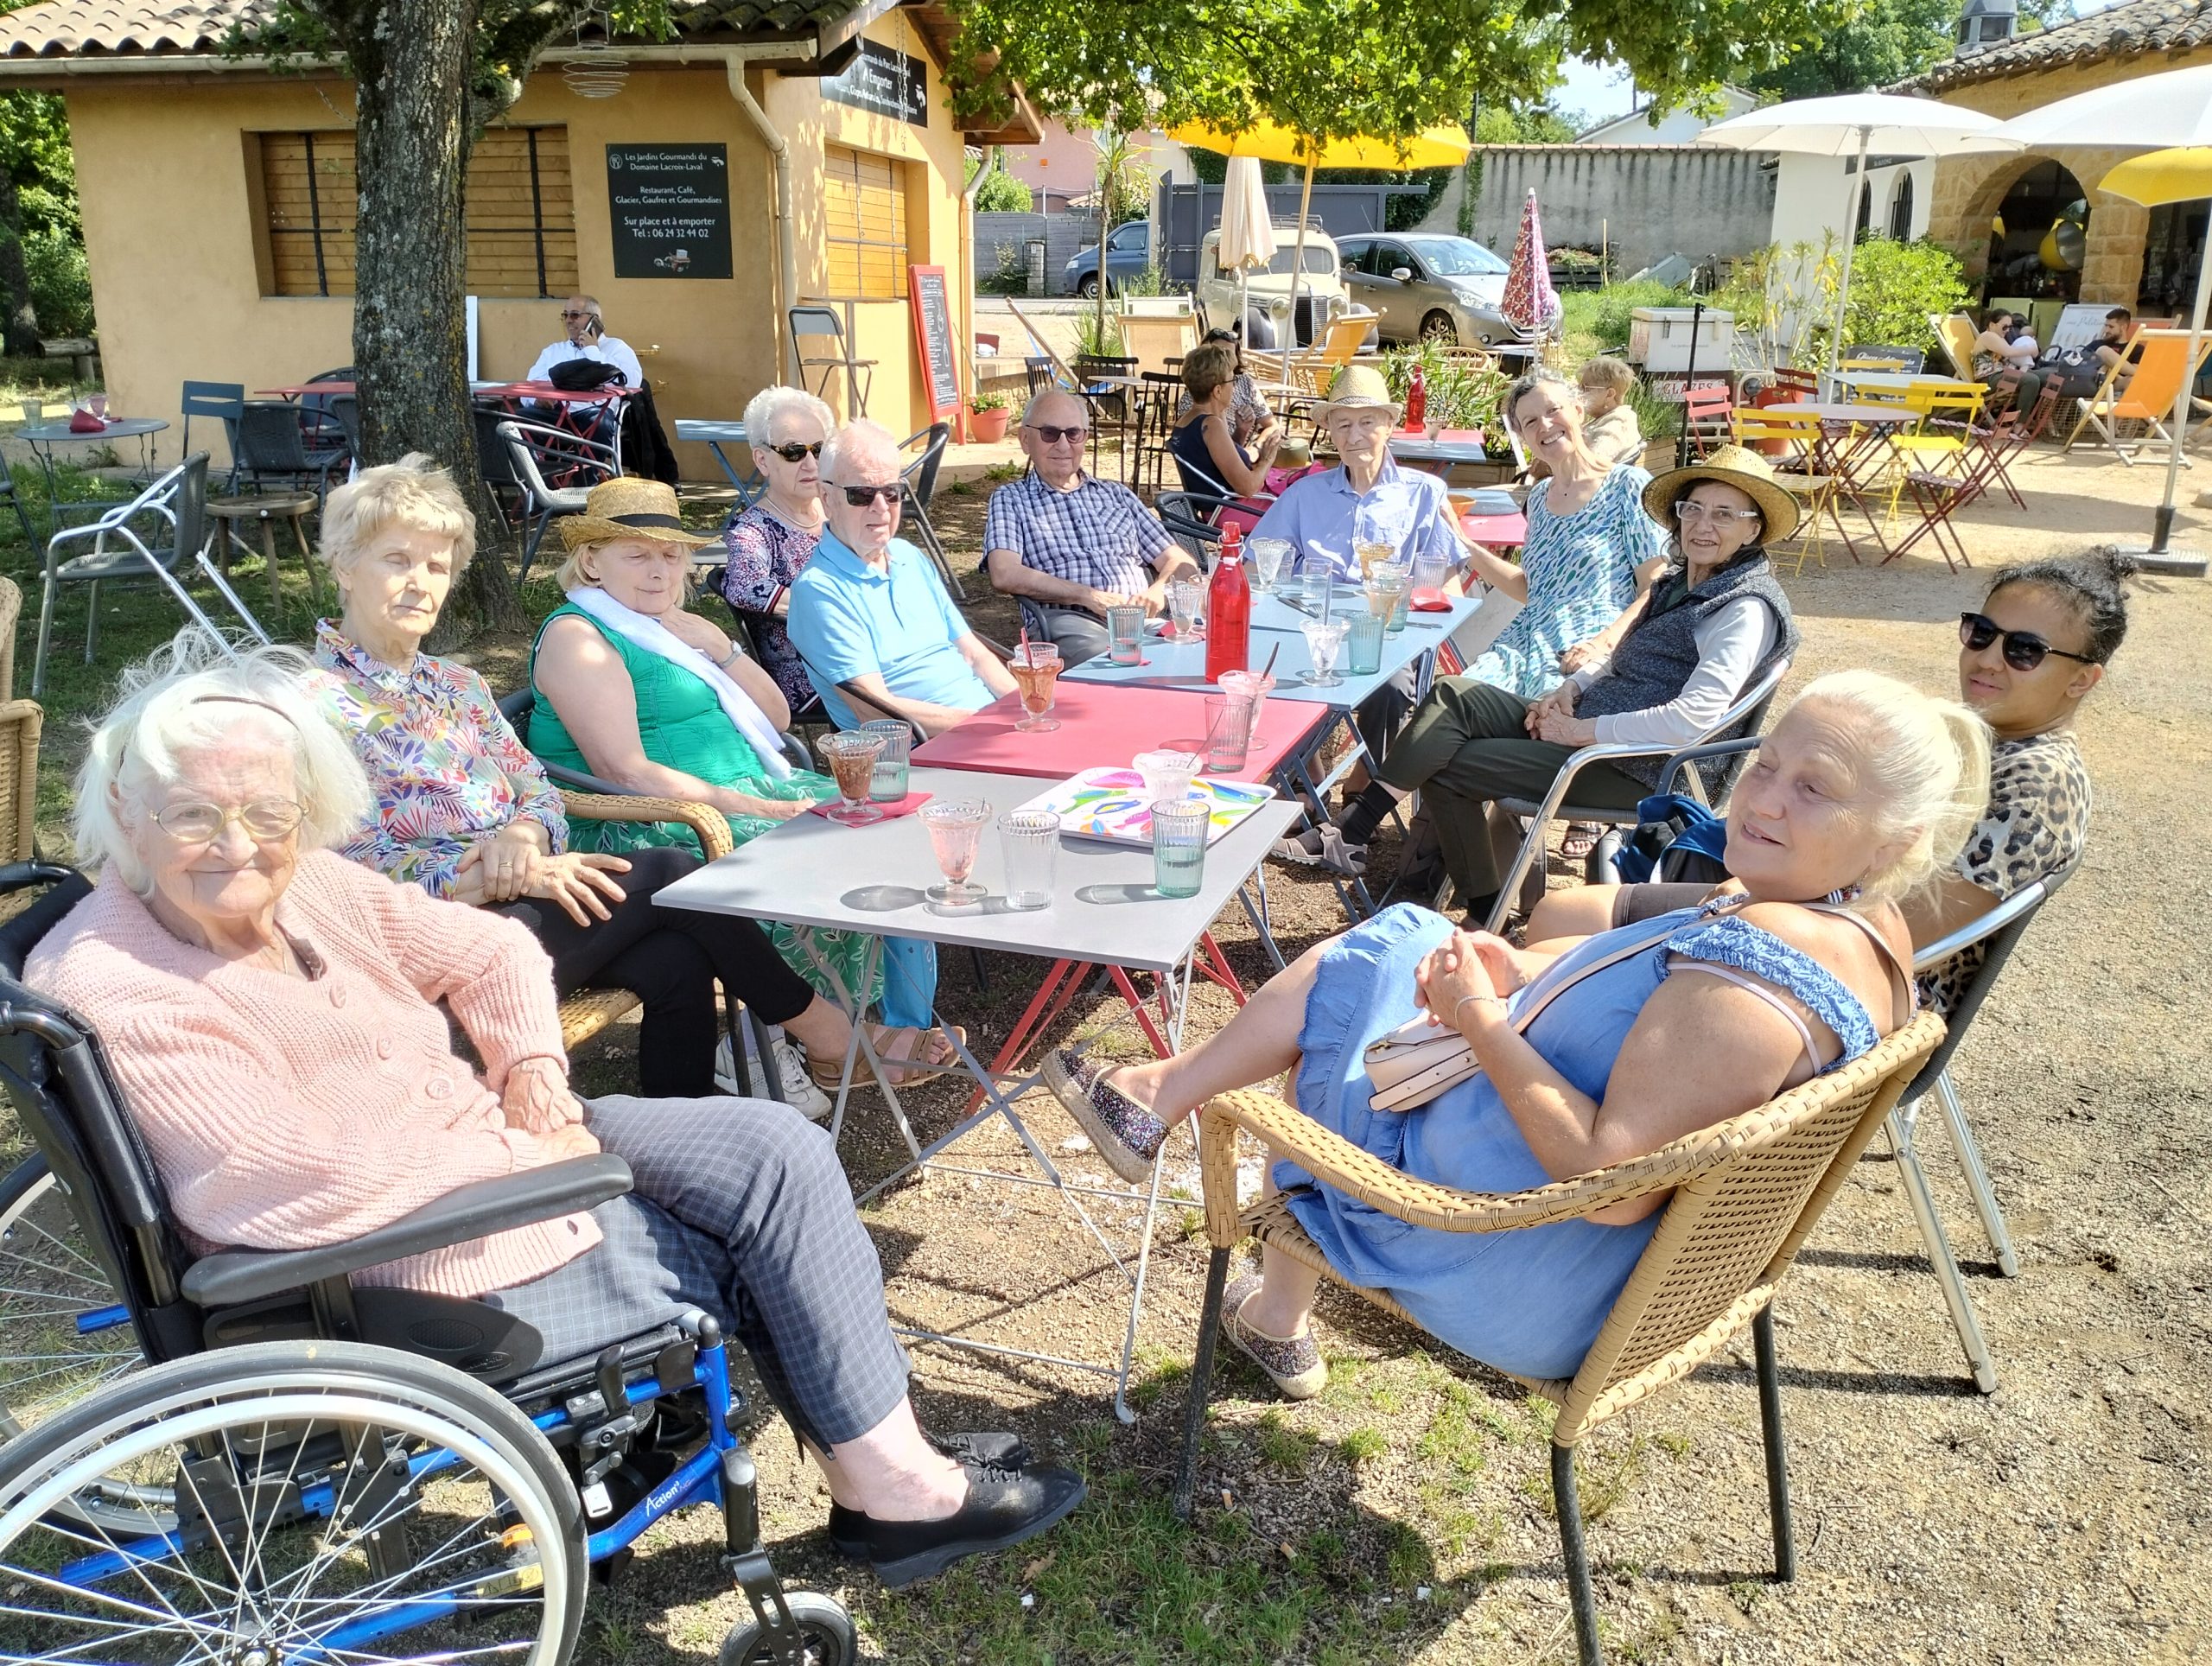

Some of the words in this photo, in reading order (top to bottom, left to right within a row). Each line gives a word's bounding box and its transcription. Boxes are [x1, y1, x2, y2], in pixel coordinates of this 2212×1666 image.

[869, 68, 893, 91] Emporter
[637, 152, 658, 162] Jardins
[698, 152, 707, 161] du
[677, 186, 696, 194] Café,
[615, 196, 641, 205] Glacier,
[624, 216, 637, 225] Sur
[639, 216, 660, 227] place
[678, 217, 715, 227] emporter
[632, 229, 645, 238] Tel
[652, 229, 663, 238] 06
[665, 229, 674, 238] 24
[677, 229, 685, 238] 32
[687, 229, 696, 238] 44
[698, 229, 709, 238] 02
